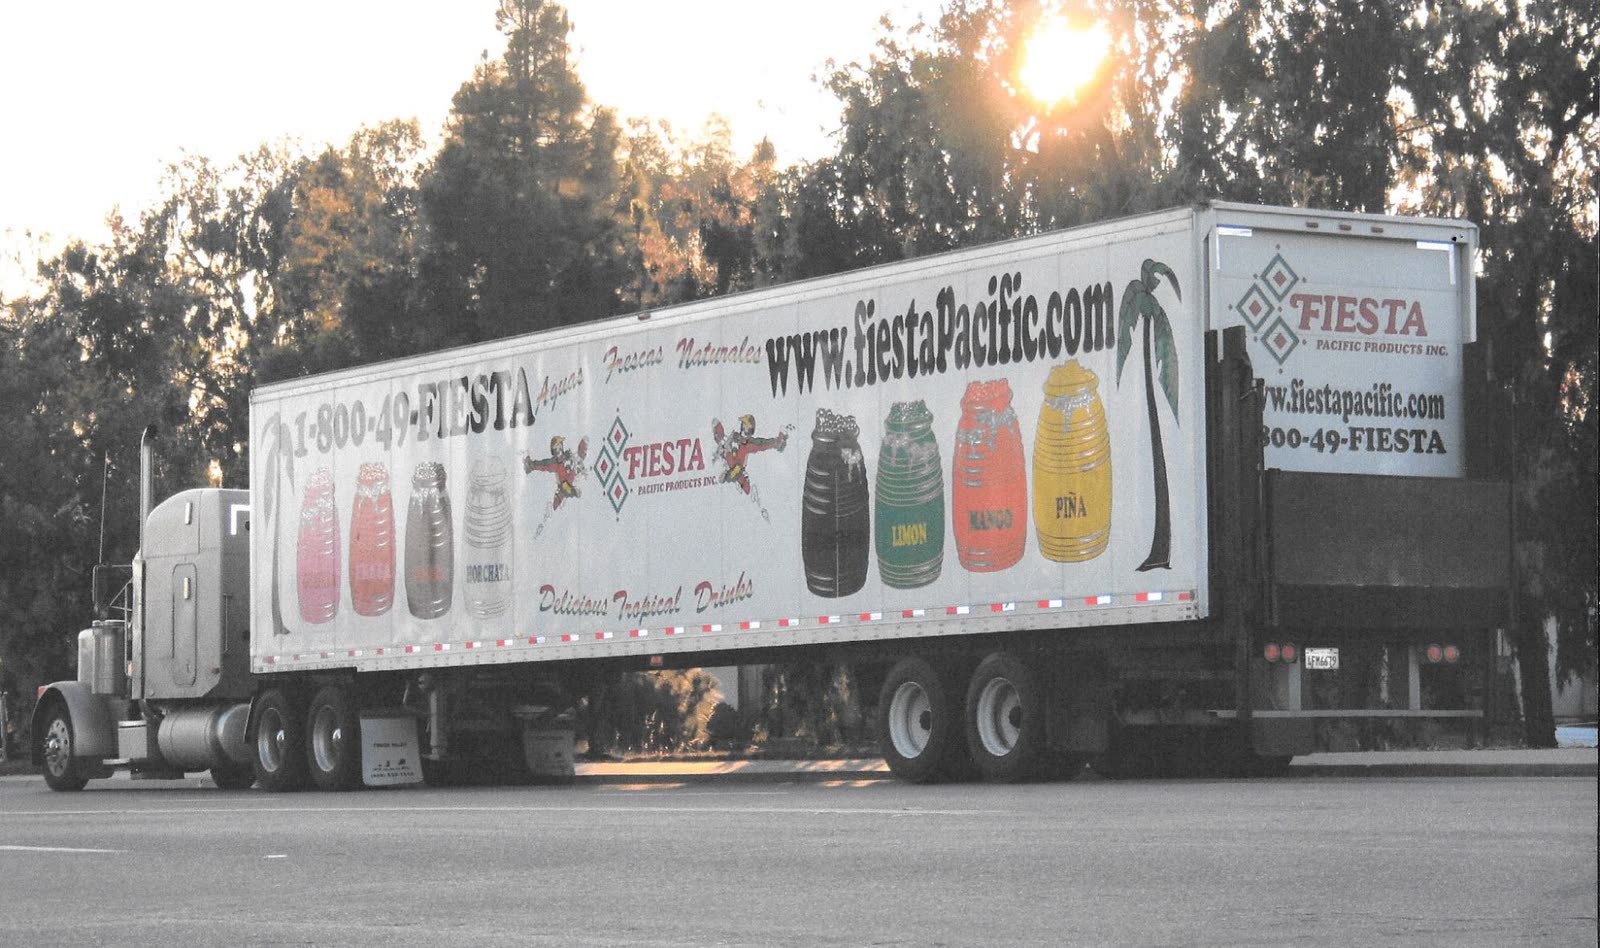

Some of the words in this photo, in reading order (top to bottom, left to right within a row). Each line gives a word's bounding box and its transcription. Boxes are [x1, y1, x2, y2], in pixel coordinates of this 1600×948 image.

[1289, 293, 1428, 336] FIESTA
[766, 271, 1116, 398] www.fiestaPacific.com
[1316, 339, 1362, 352] PACIFIC
[1364, 342, 1423, 355] PRODUCTS
[1425, 345, 1449, 356] INC.
[535, 367, 584, 415] Aguas
[603, 346, 663, 384] Frescas
[676, 336, 761, 369] Naturales
[294, 366, 536, 458] 1-800-49-FIESTA
[623, 437, 705, 480] FIESTA
[637, 483, 665, 496] PACIFIC
[665, 477, 702, 491] PRODUCTS
[703, 475, 718, 487] INC.
[968, 508, 1013, 530] MANGO
[1055, 491, 1087, 519] PIÑA
[891, 522, 928, 547] LIMON
[466, 563, 510, 583] HORCHATA
[539, 584, 608, 616] Delicious
[613, 586, 683, 625] Tropical
[694, 570, 753, 614] Drinks
